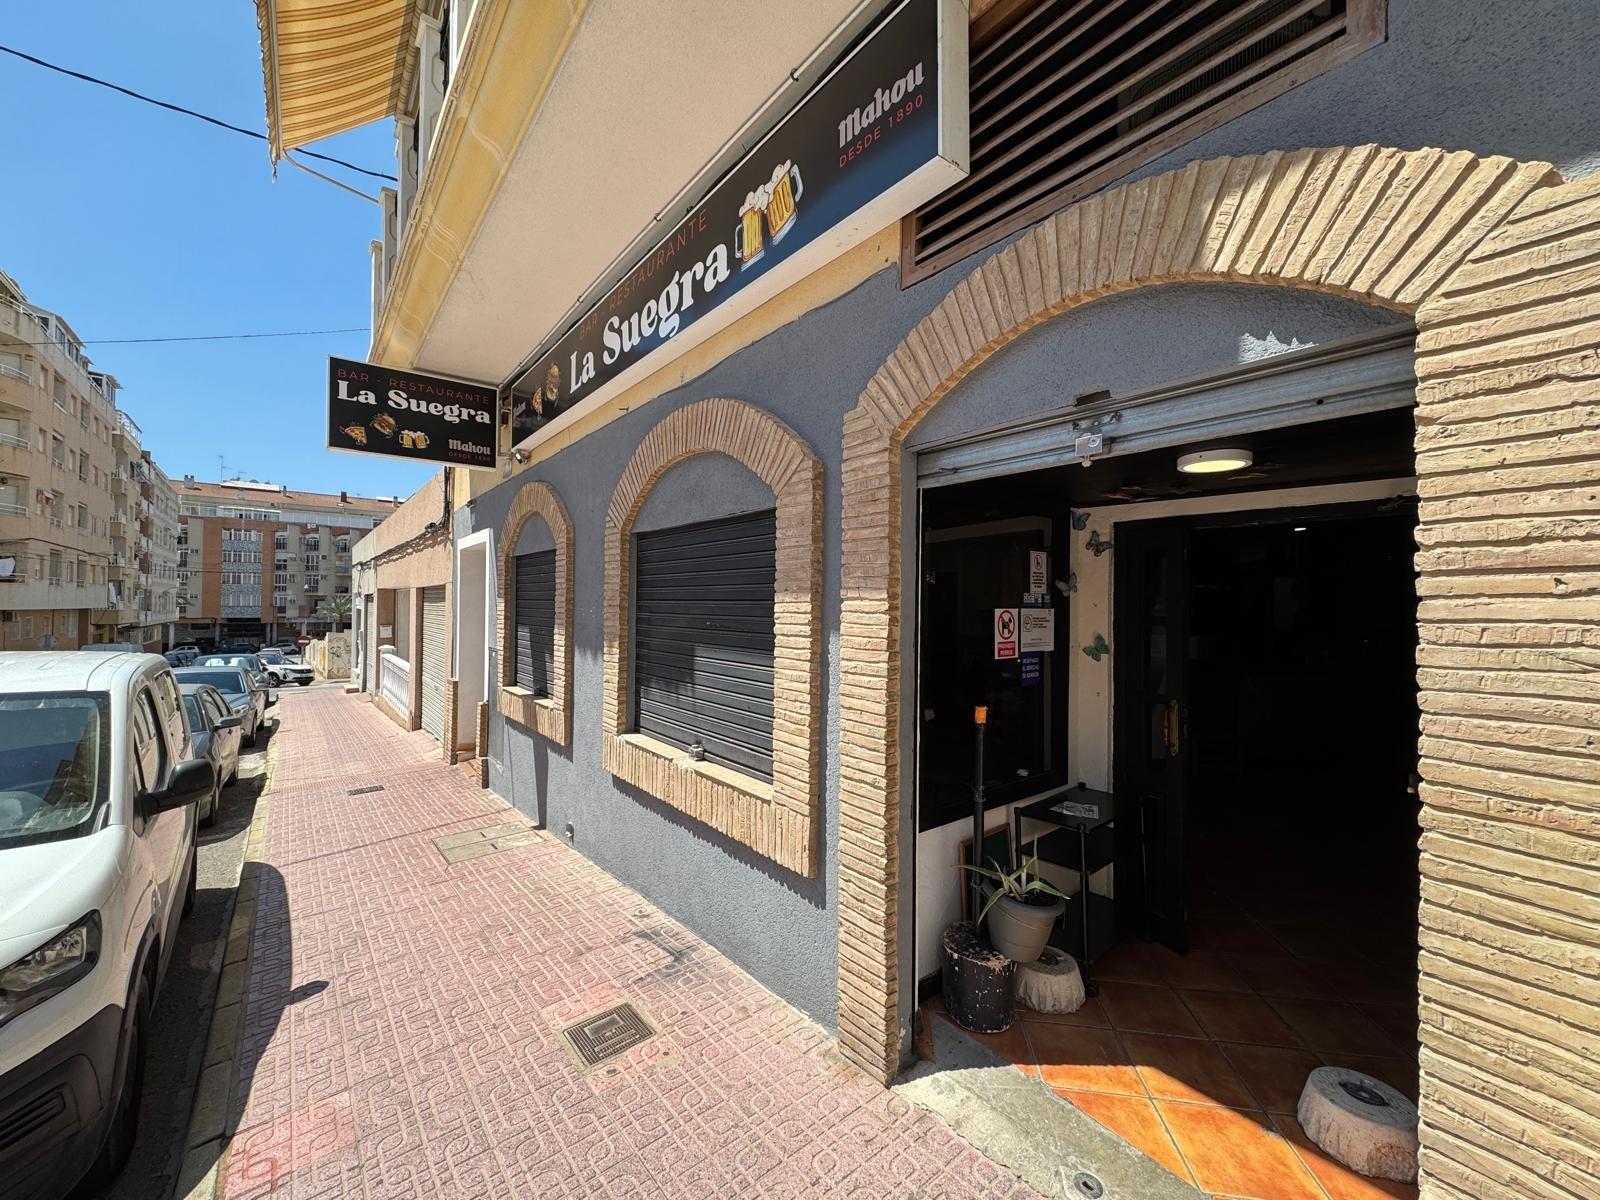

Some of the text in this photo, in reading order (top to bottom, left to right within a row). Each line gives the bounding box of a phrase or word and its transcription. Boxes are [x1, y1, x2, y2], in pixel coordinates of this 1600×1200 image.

[838, 61, 925, 148] Mahou
[839, 94, 923, 168] DESDE 1890
[578, 317, 598, 341] BAR
[609, 208, 707, 311] RESTAURANTE
[569, 243, 730, 394] La Suegra
[337, 368, 369, 382] BAR
[389, 378, 489, 404] RESTAURANTE
[337, 379, 377, 405] La
[387, 389, 491, 424] Suegra
[448, 438, 491, 455] Mahou
